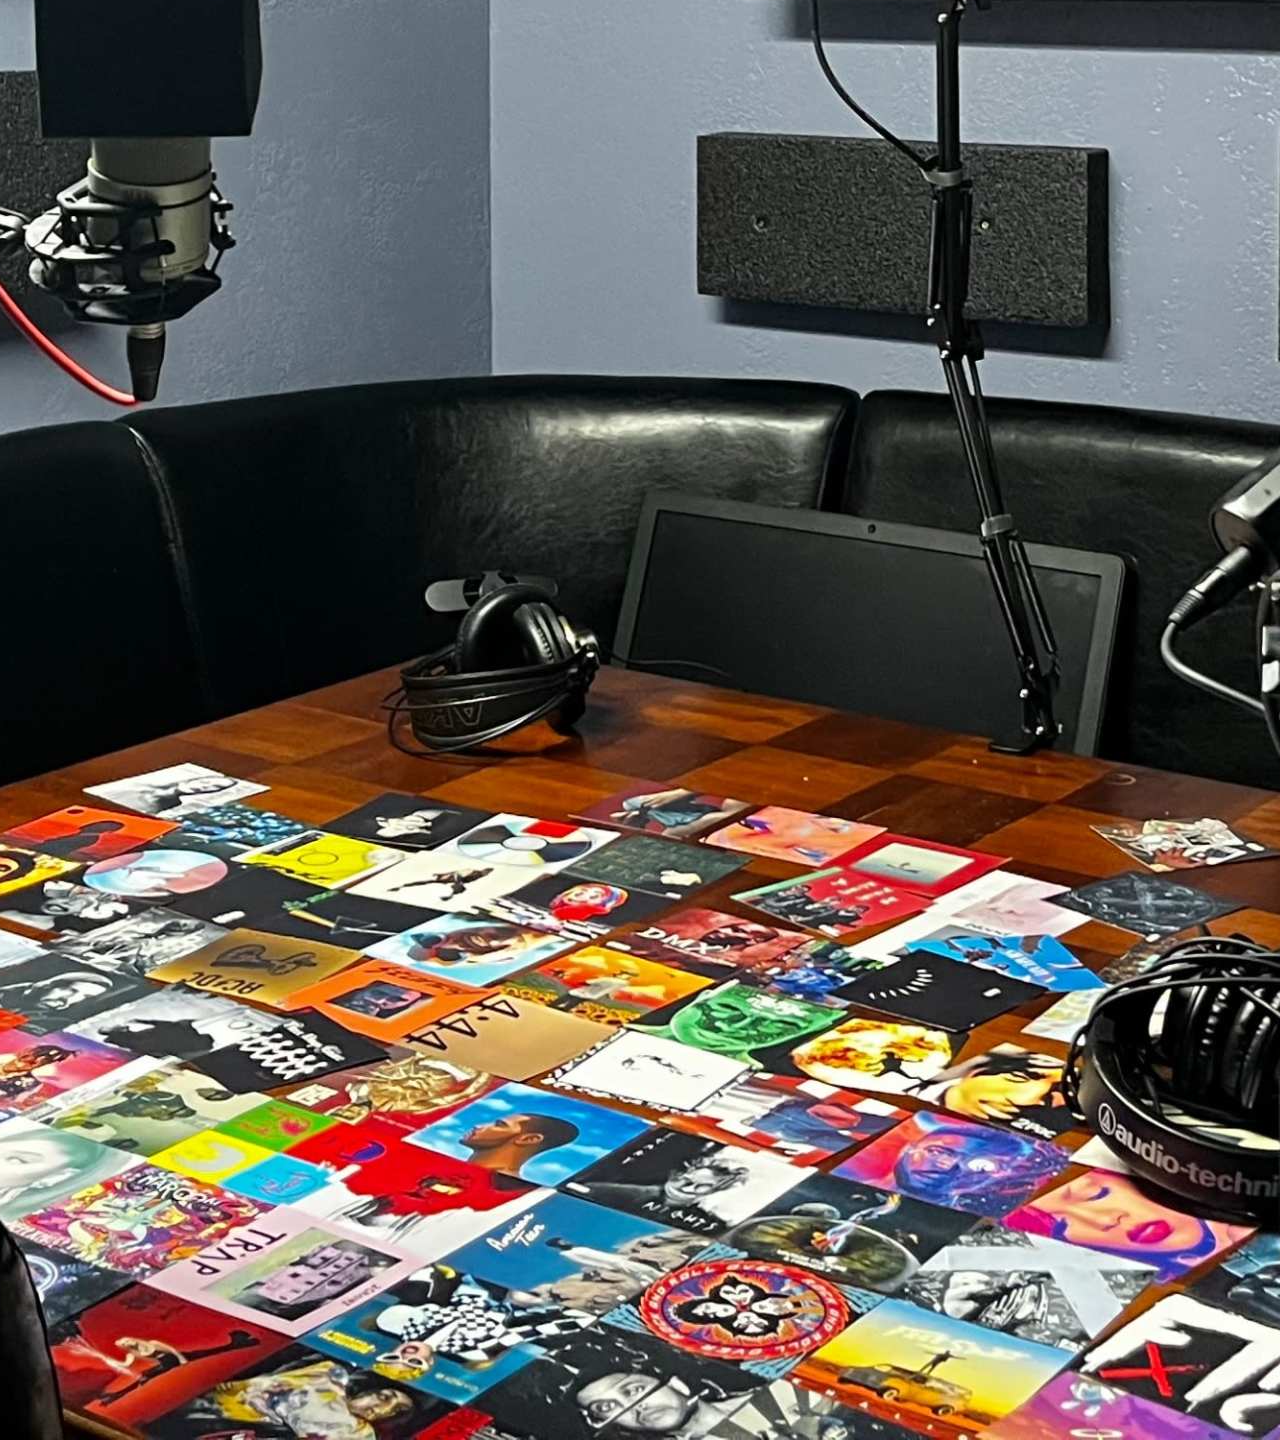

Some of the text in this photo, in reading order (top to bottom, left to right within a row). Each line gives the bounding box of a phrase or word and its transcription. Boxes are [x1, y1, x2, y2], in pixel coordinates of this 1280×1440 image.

[631, 927, 725, 955] DMX
[1114, 1122, 1280, 1198] audio-techni
[190, 1227, 288, 1277] TRAP
